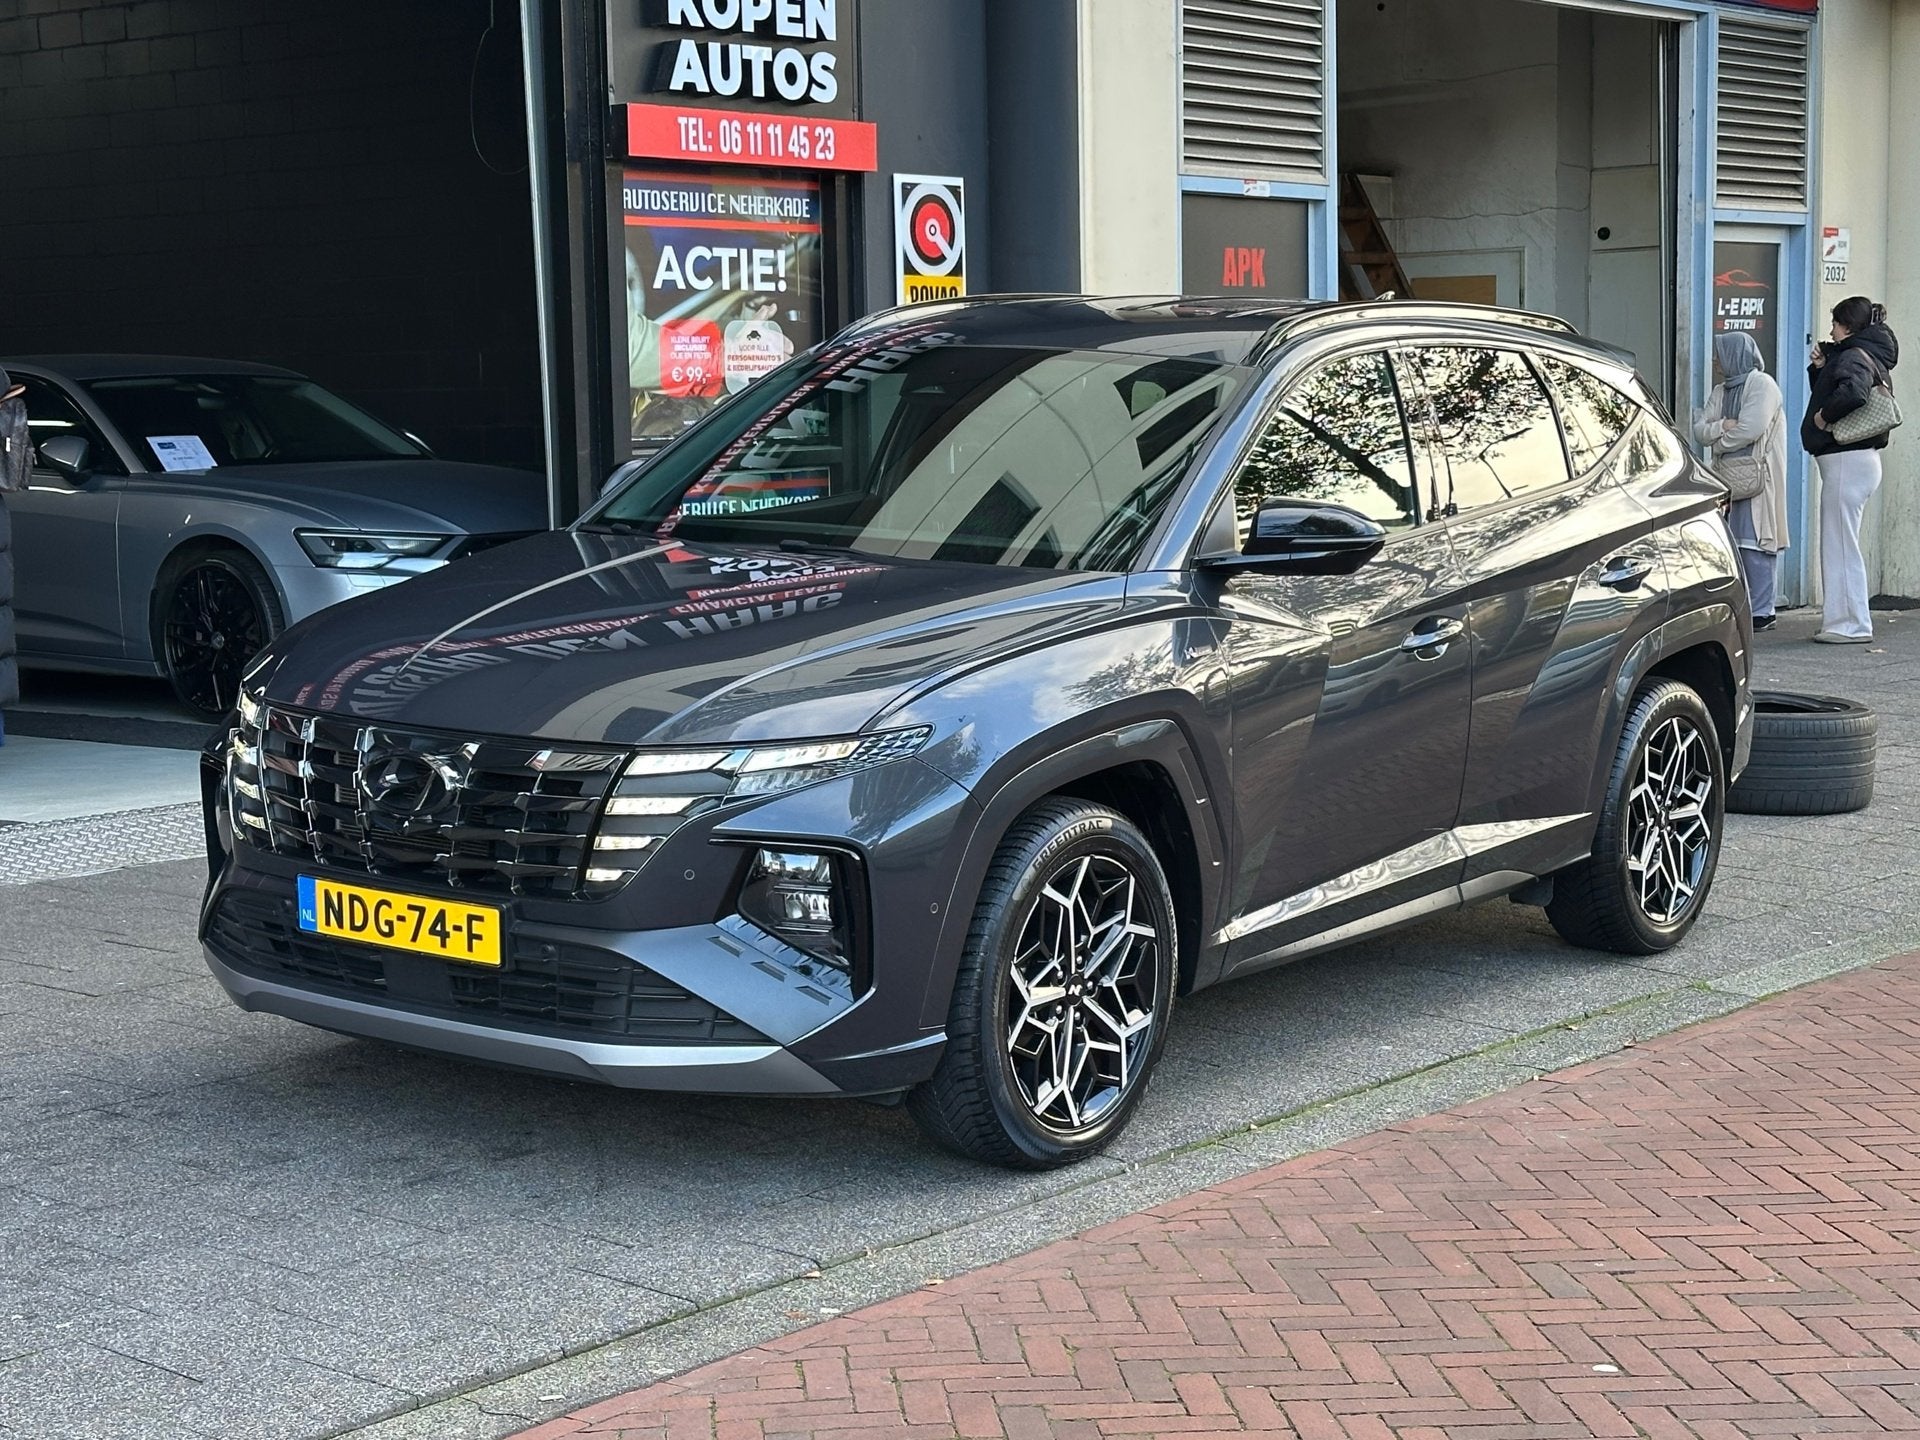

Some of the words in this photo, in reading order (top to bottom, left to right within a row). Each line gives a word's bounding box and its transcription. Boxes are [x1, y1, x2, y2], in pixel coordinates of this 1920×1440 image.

[668, 0, 837, 41] KOPEN
[669, 39, 838, 103] AUTOS
[678, 116, 712, 153] TEL:
[719, 118, 742, 155] 06
[747, 121, 763, 157] 11
[767, 122, 783, 158] 11
[788, 124, 810, 159] 45
[815, 126, 835, 161] 23
[729, 194, 811, 218] NEHERKADE
[652, 245, 787, 293] ACTIE!
[1222, 247, 1266, 288] APK
[1825, 266, 1846, 282] 2032
[1740, 298, 1765, 316] APK
[1032, 819, 1104, 871] GREENTRAC
[302, 909, 316, 922] NL
[323, 888, 485, 953] NDG-74-F
